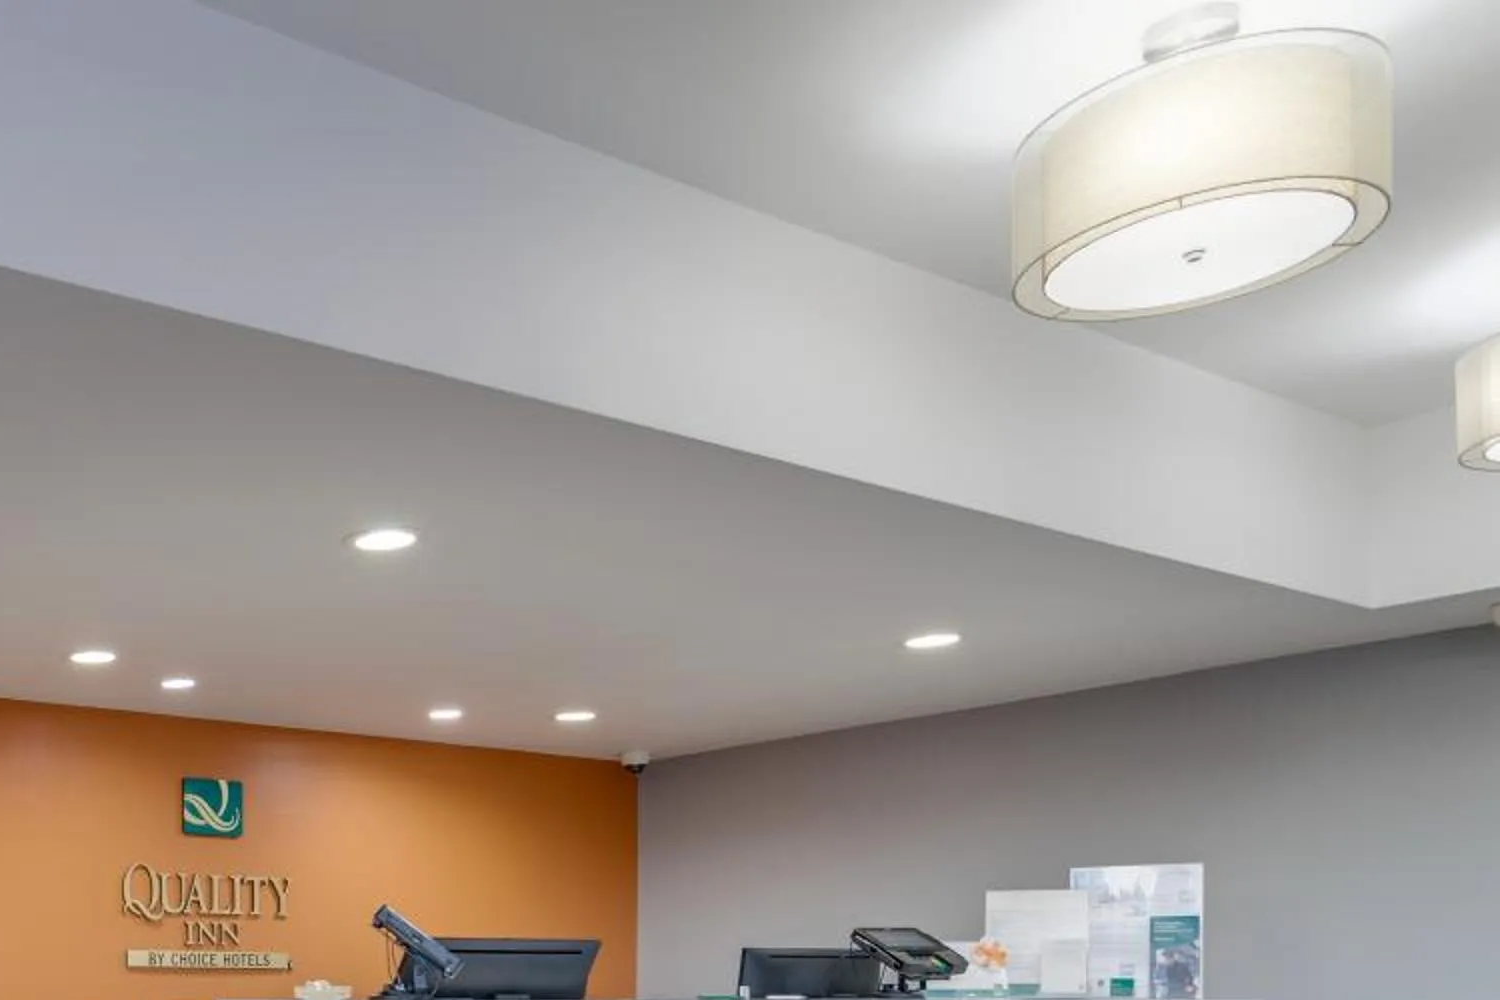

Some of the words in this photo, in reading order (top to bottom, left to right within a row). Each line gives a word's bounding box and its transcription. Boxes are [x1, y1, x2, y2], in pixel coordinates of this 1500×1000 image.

[123, 863, 290, 921] QUALITY
[184, 920, 240, 946] INN
[148, 951, 165, 968] BY
[171, 952, 218, 968] CHOICE
[223, 953, 271, 968] HOTELS
